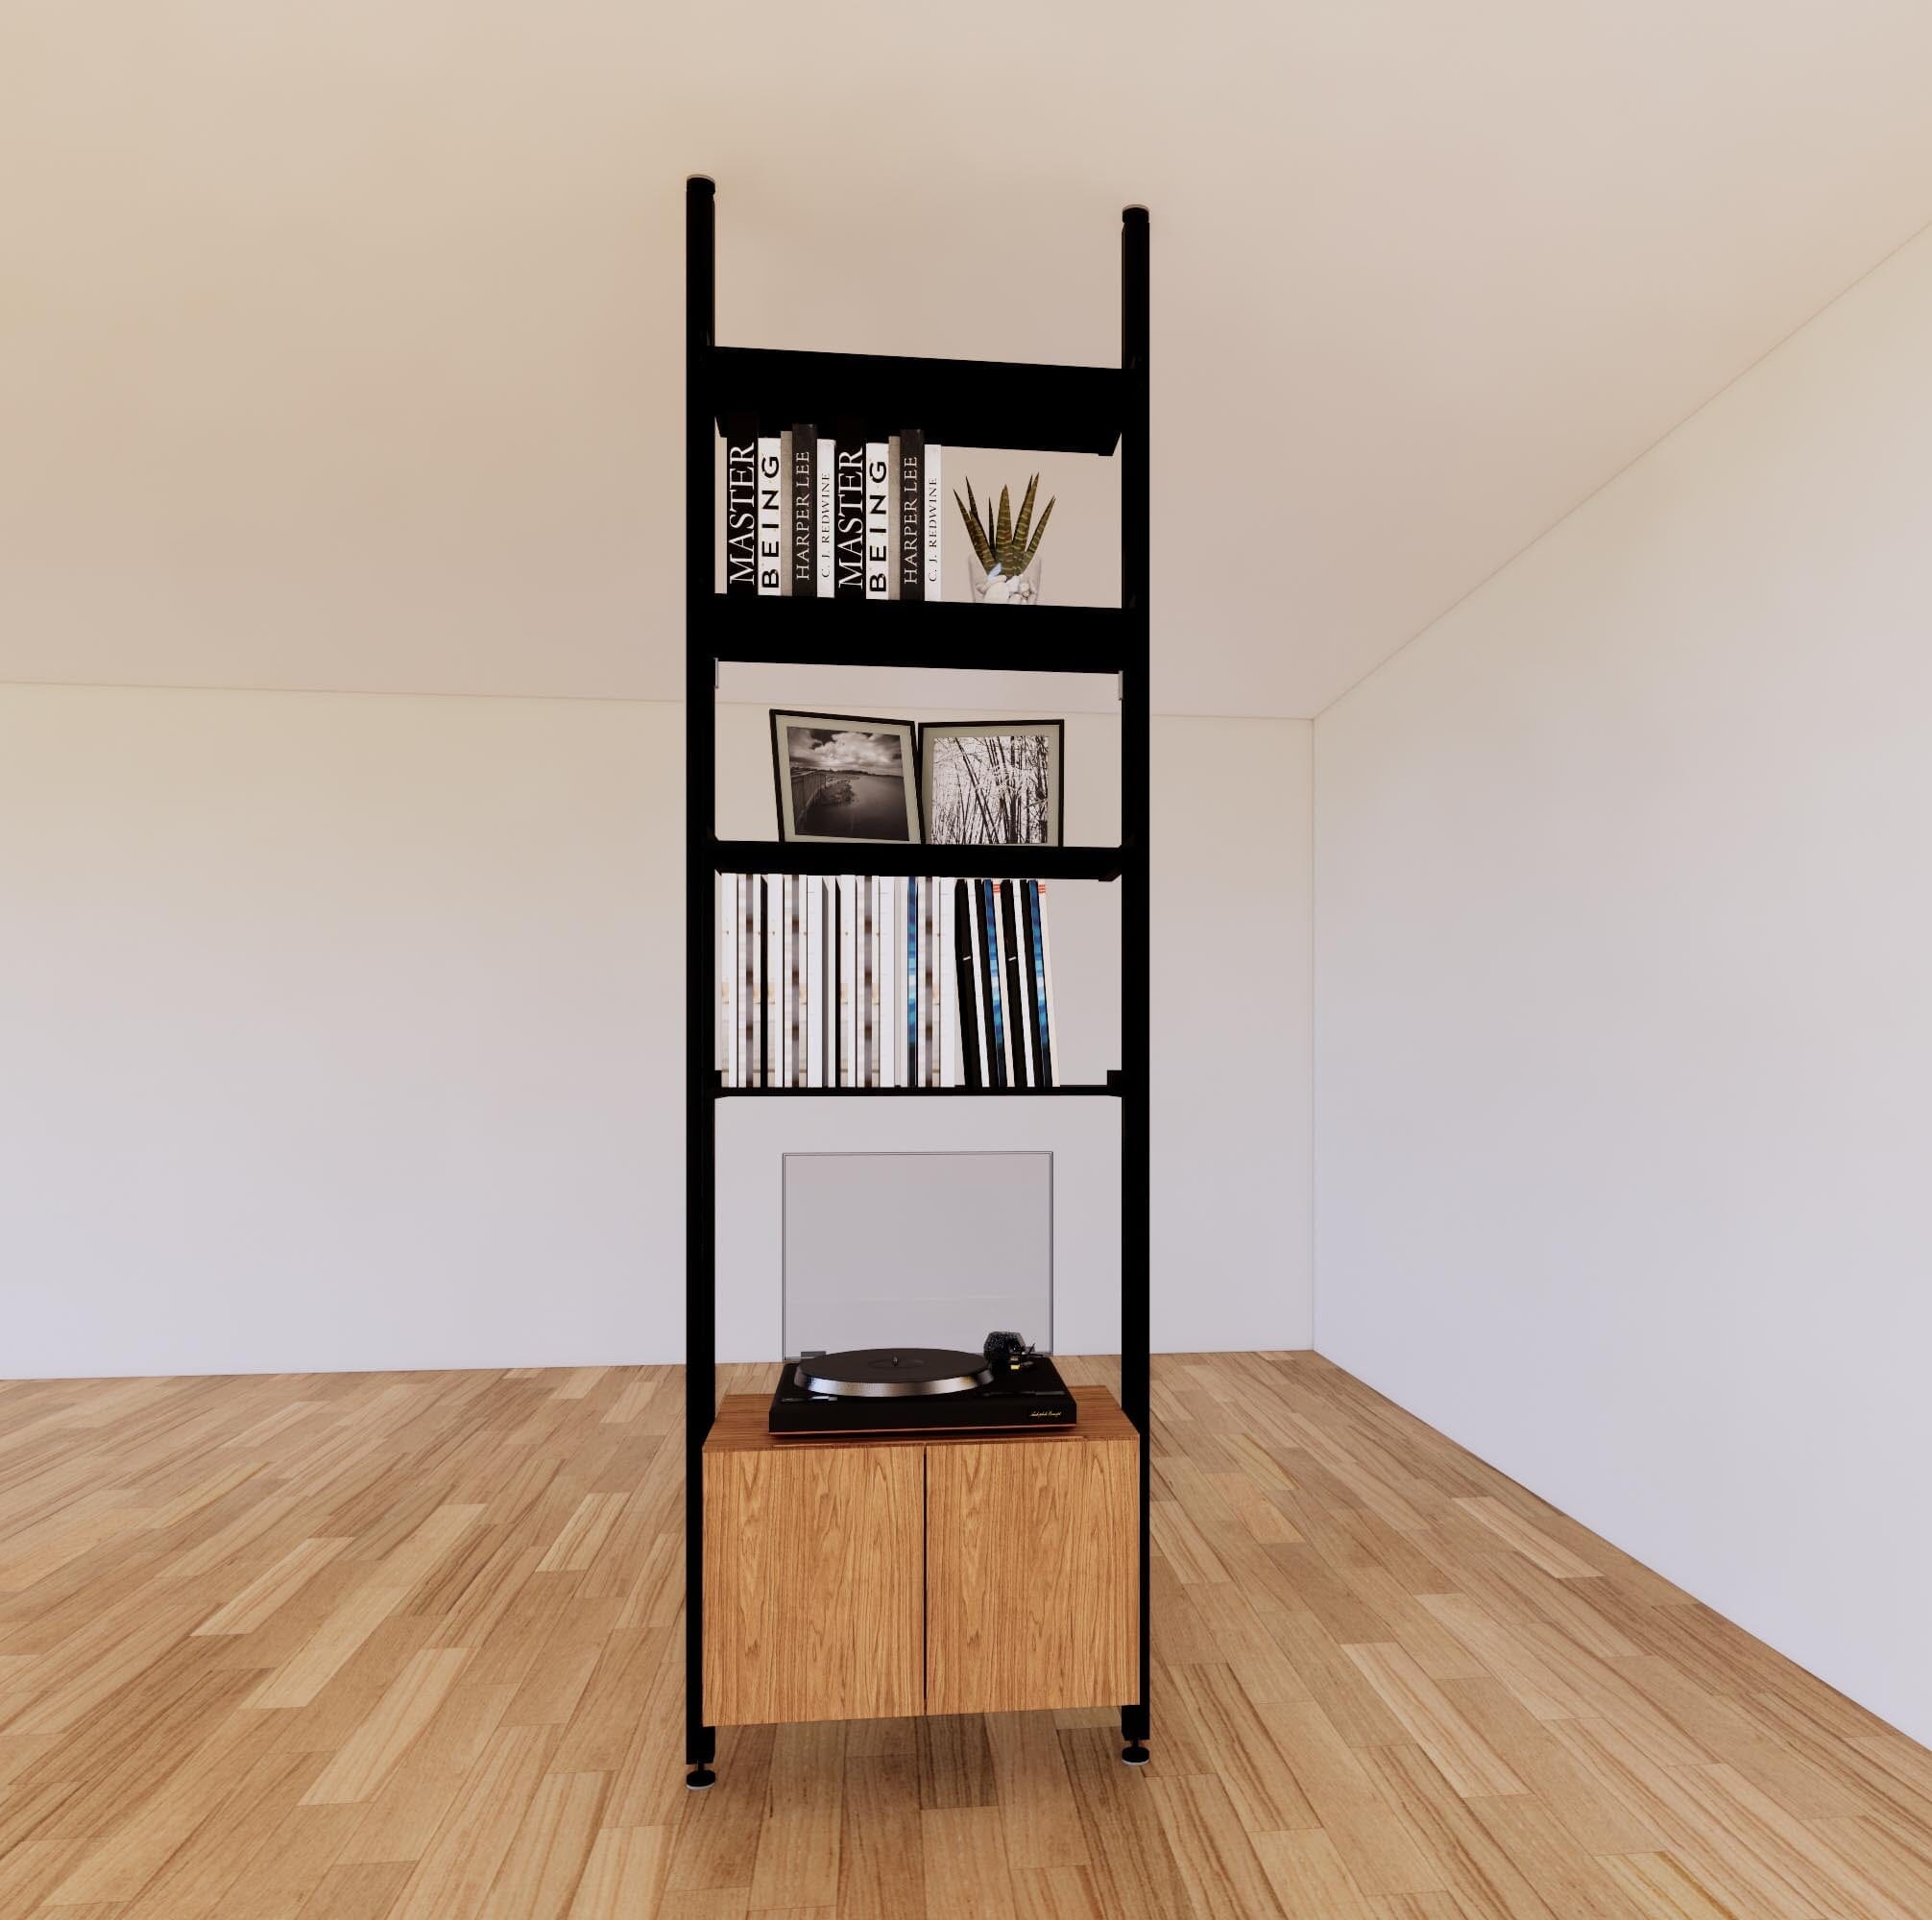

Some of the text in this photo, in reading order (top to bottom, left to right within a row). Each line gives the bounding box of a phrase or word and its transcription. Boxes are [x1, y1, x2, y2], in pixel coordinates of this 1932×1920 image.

[729, 442, 755, 586] MASTER
[762, 456, 780, 588] BEING
[796, 451, 809, 581] HARPER LEE
[822, 473, 831, 544] REDWINE
[822, 565, 831, 578] C.
[838, 447, 863, 589] MASTER
[869, 461, 886, 592] BEING
[904, 457, 918, 584] HARPER LEE
[929, 478, 937, 548] REDWINE
[929, 569, 937, 582] C.
